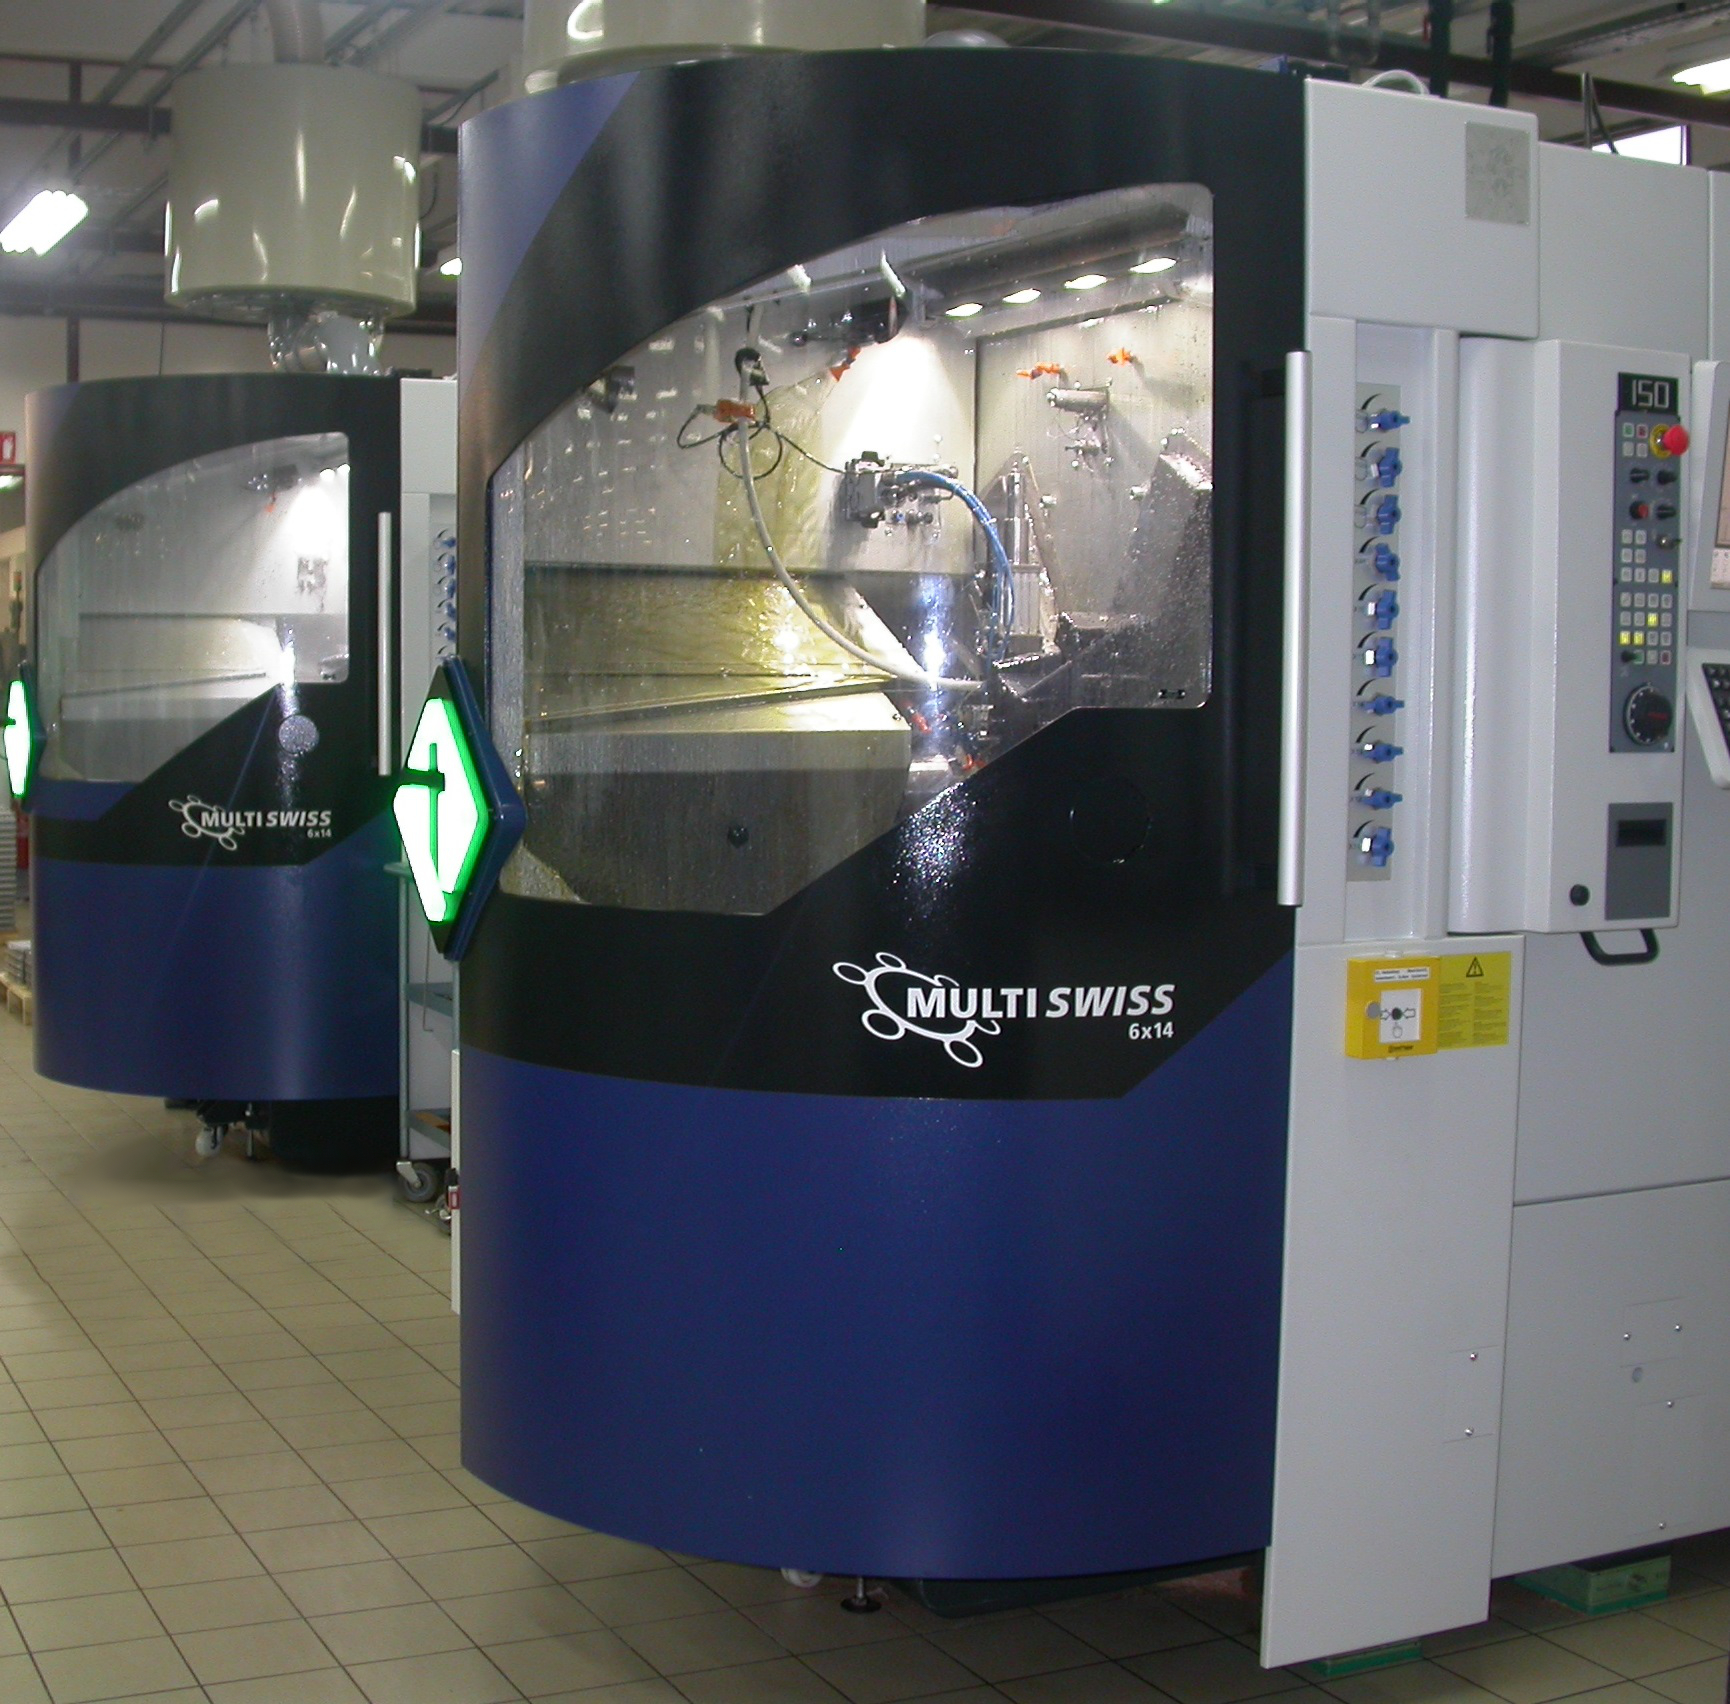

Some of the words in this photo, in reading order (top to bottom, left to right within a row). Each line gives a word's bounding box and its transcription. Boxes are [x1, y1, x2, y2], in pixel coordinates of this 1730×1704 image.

[201, 811, 262, 827] MULTI
[266, 810, 332, 827] SWISS
[307, 828, 332, 838] 6x14
[906, 988, 1037, 1018] MULTI
[1045, 984, 1175, 1018] SWISS
[1128, 1022, 1174, 1040] 6x14
